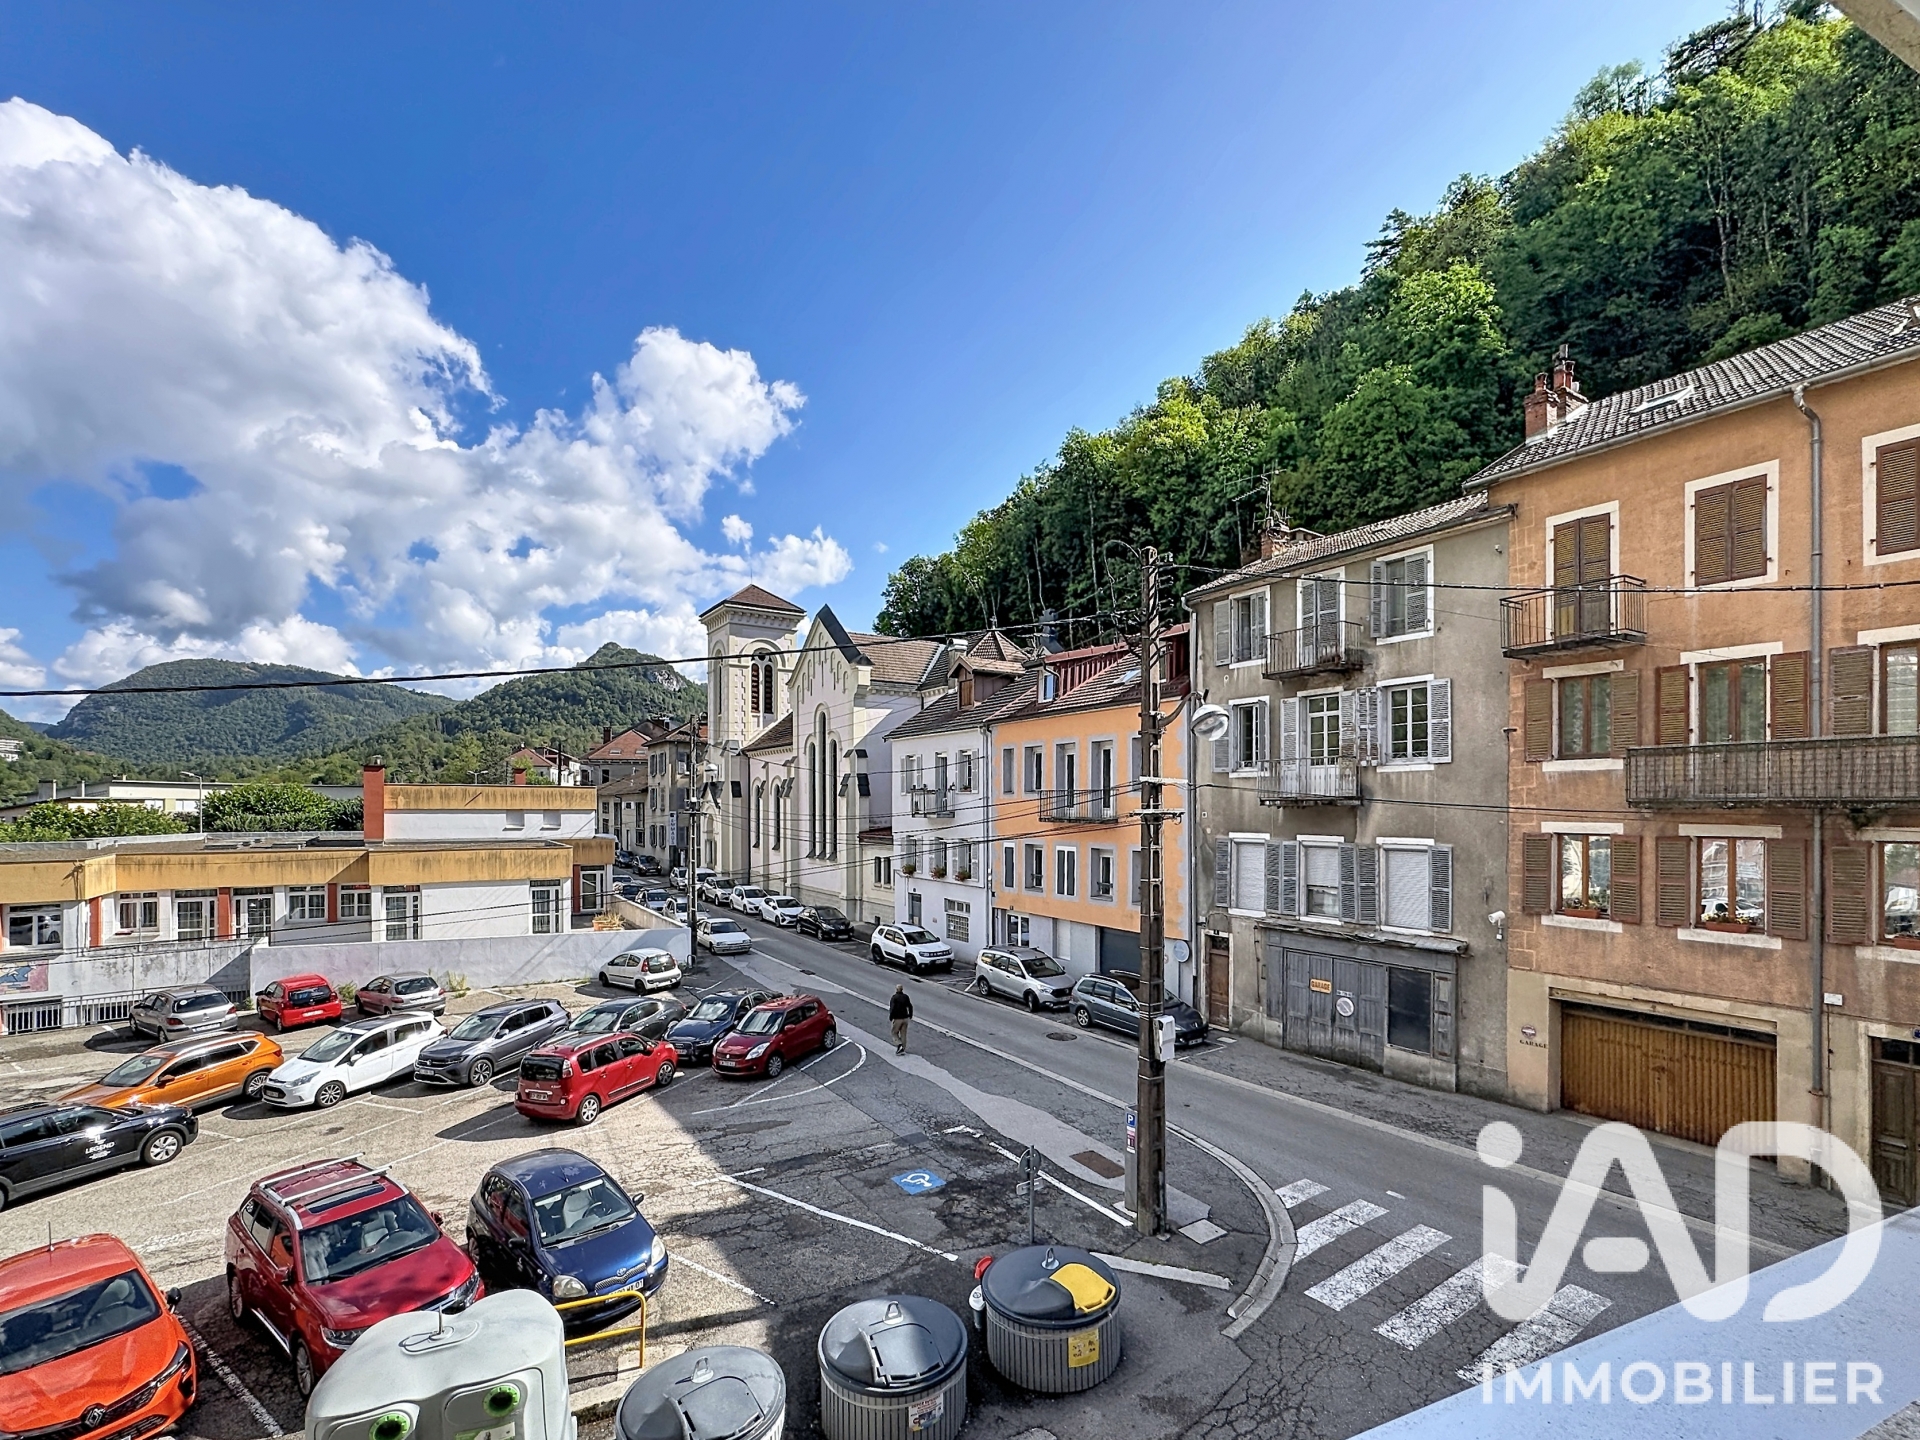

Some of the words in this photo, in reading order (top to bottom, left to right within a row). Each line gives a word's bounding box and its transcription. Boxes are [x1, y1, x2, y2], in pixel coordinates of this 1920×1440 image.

[1311, 980, 1330, 991] GARAGE
[1519, 1039, 1549, 1049] GARAGE
[85, 1141, 116, 1155] LEGEND
